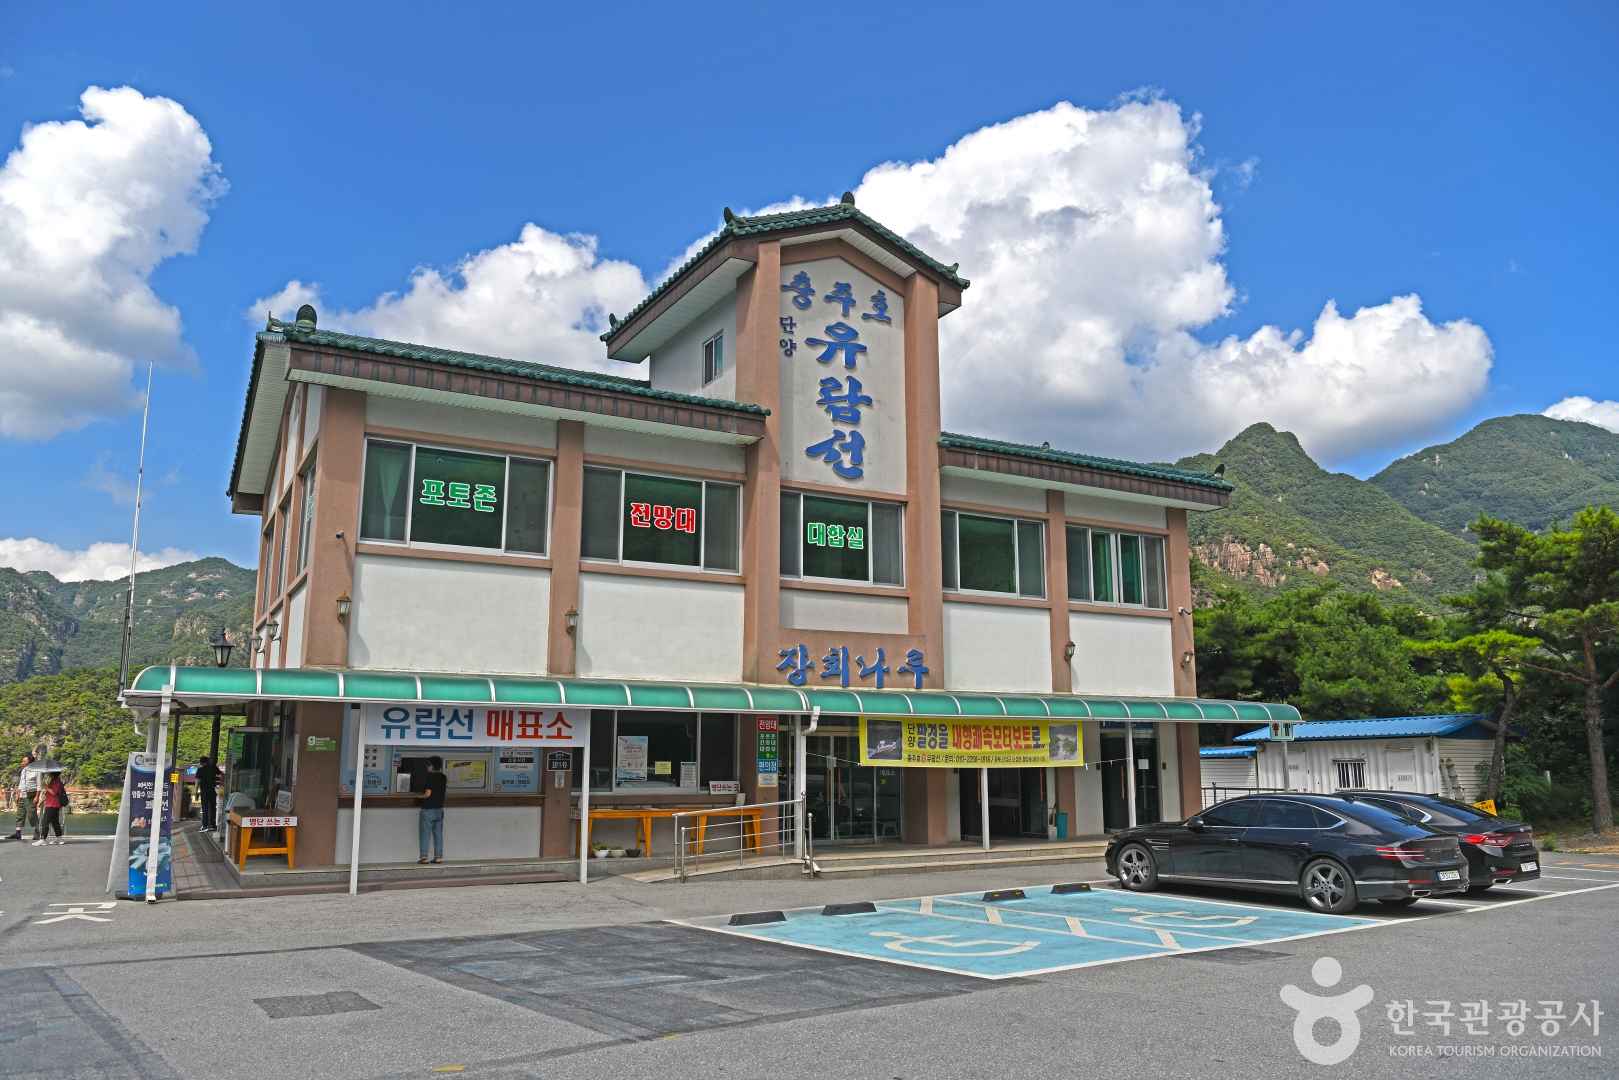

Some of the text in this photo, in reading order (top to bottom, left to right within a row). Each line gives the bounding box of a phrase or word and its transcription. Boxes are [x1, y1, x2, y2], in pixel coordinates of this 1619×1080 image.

[780, 316, 797, 357] 단양
[804, 321, 873, 479] 유람선
[420, 479, 498, 513] 포토존
[630, 502, 697, 534] 전망대
[807, 522, 864, 550] 대합실
[776, 643, 930, 690] 장회나루
[381, 707, 573, 741] 유람선 매표소
[265, 818, 281, 826] 쓰는
